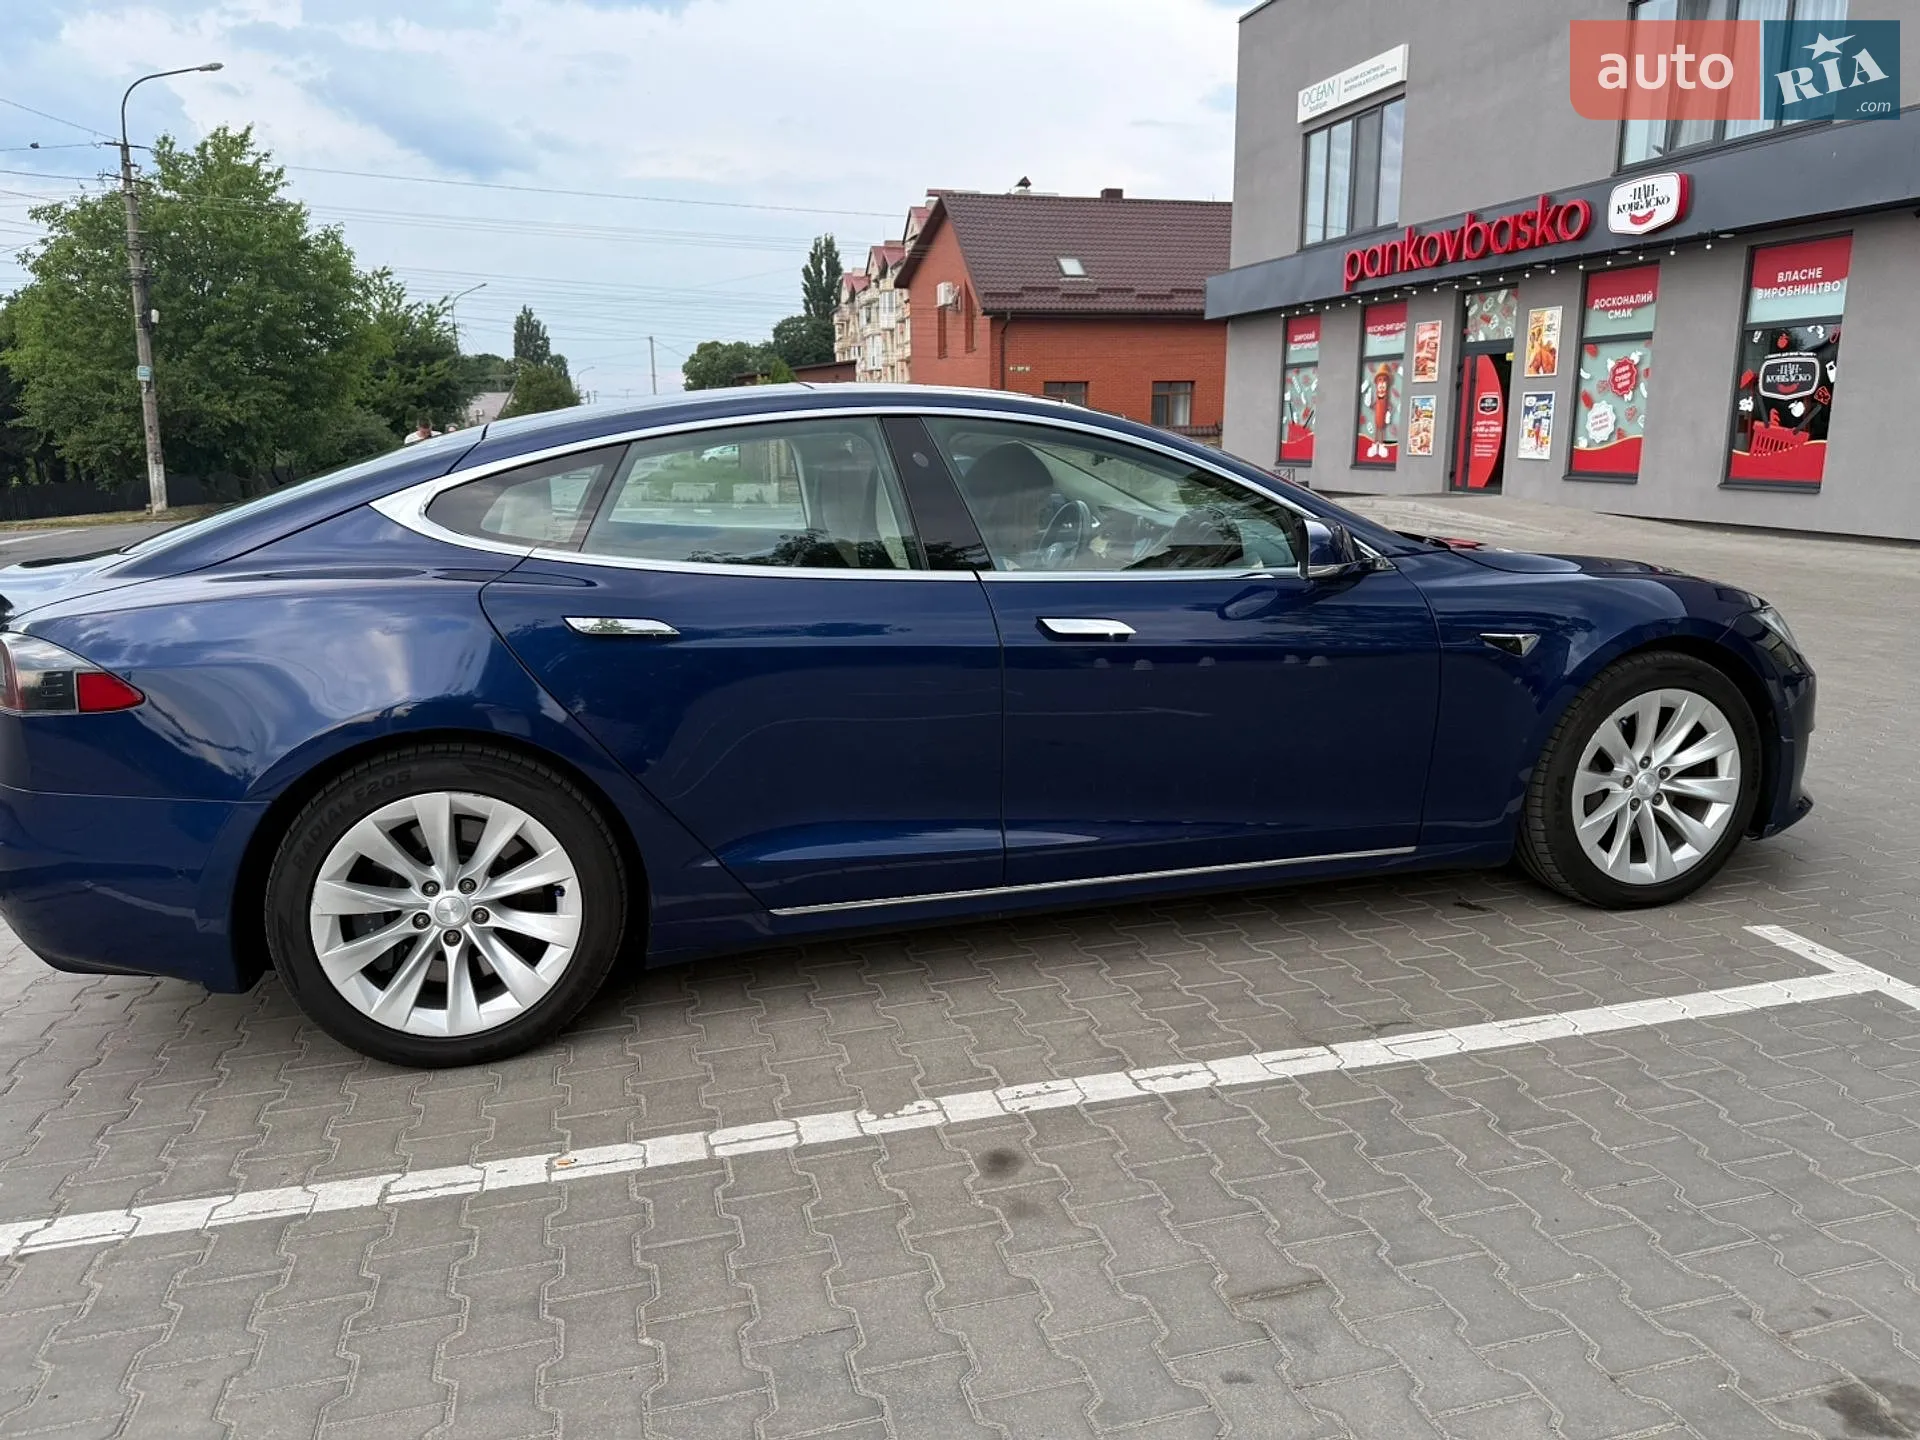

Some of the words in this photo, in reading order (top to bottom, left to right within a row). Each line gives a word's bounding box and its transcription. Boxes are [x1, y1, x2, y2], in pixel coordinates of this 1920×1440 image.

[1302, 80, 1336, 107] OCEAN
[1344, 194, 1592, 292] pankovbasko
[1777, 267, 1823, 282] ВЛАСНЕ
[1593, 290, 1654, 311] ДОСКОНАЛИЙ
[1757, 281, 1841, 300] ВИРОБНИЦТВО
[1608, 308, 1633, 320] СМАК
